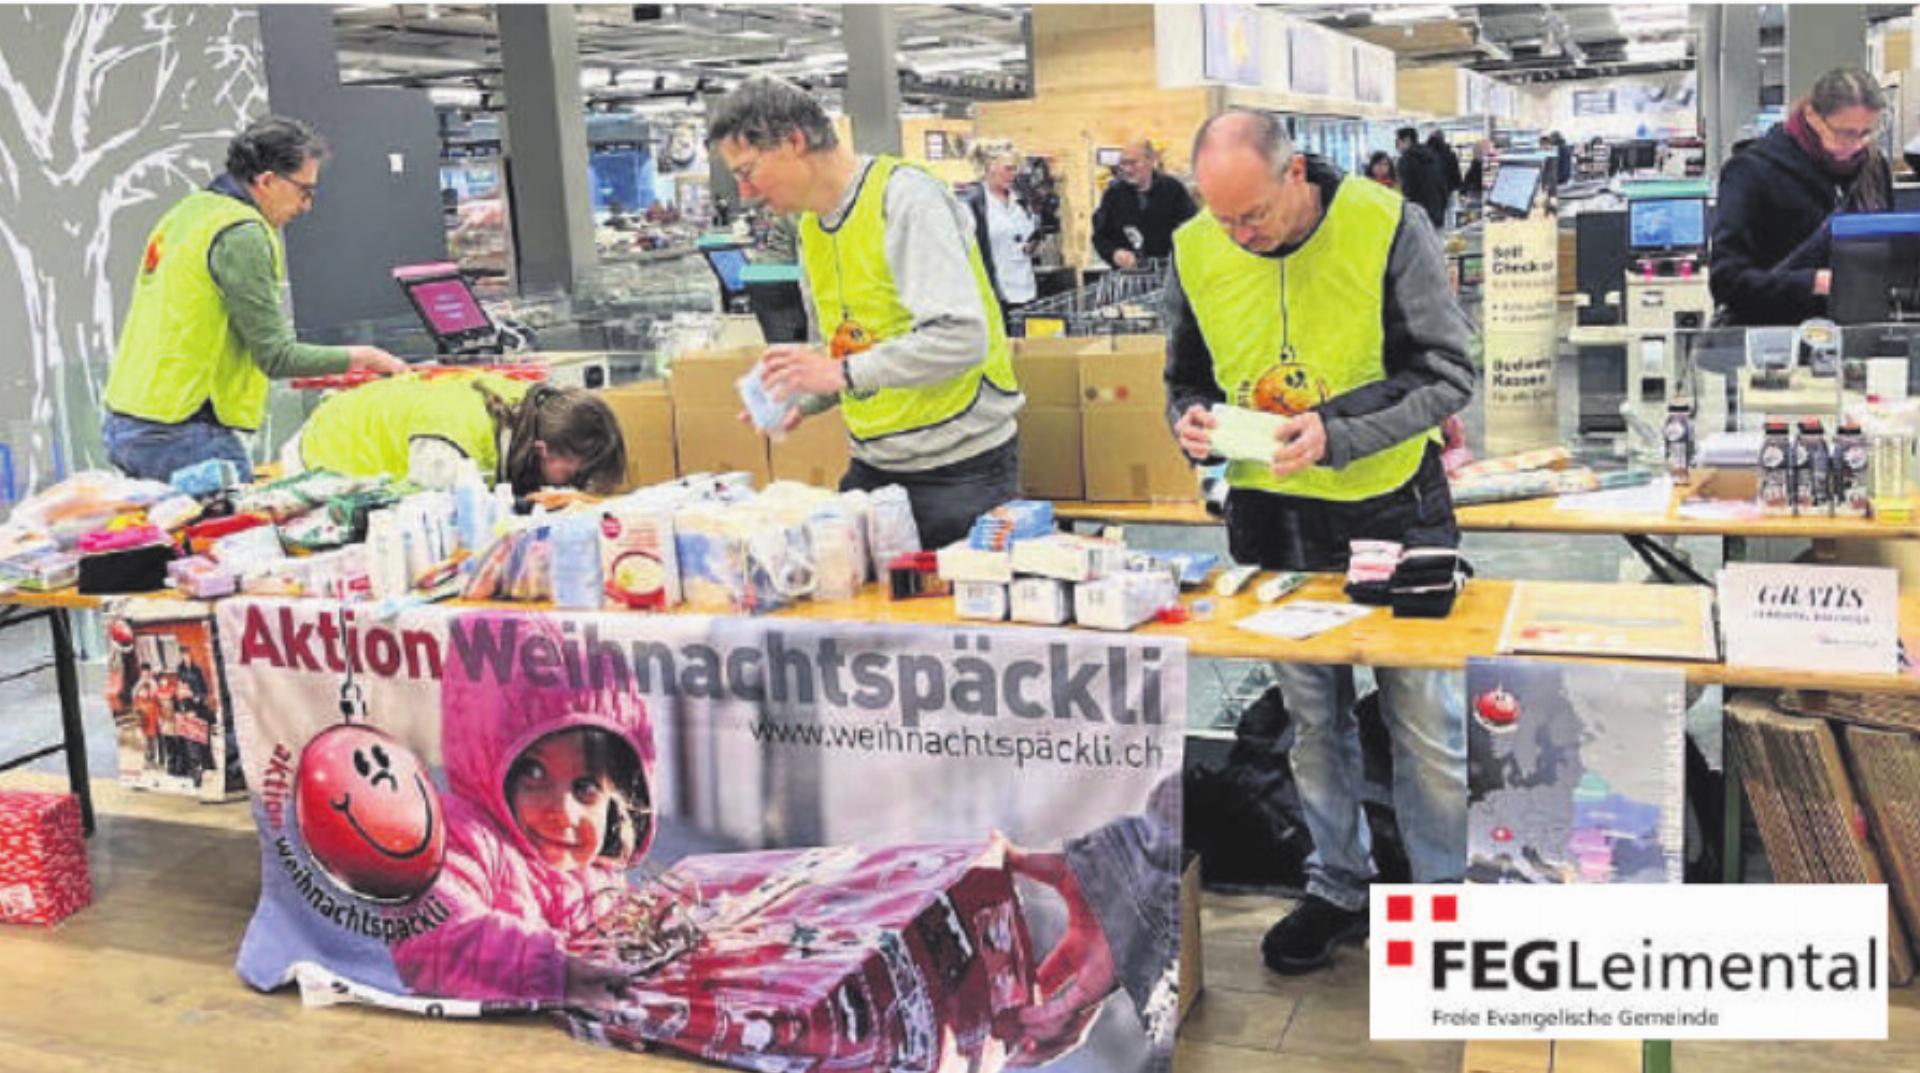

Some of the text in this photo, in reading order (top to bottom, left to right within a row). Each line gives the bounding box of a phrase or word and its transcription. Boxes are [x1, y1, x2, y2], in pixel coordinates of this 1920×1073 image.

[1758, 585, 1866, 608] GRATIS
[240, 604, 1162, 727] Aktion Weihnachtspäckli
[749, 719, 1163, 769] www.weihnachtspäckli.ch
[263, 743, 292, 829] aktion
